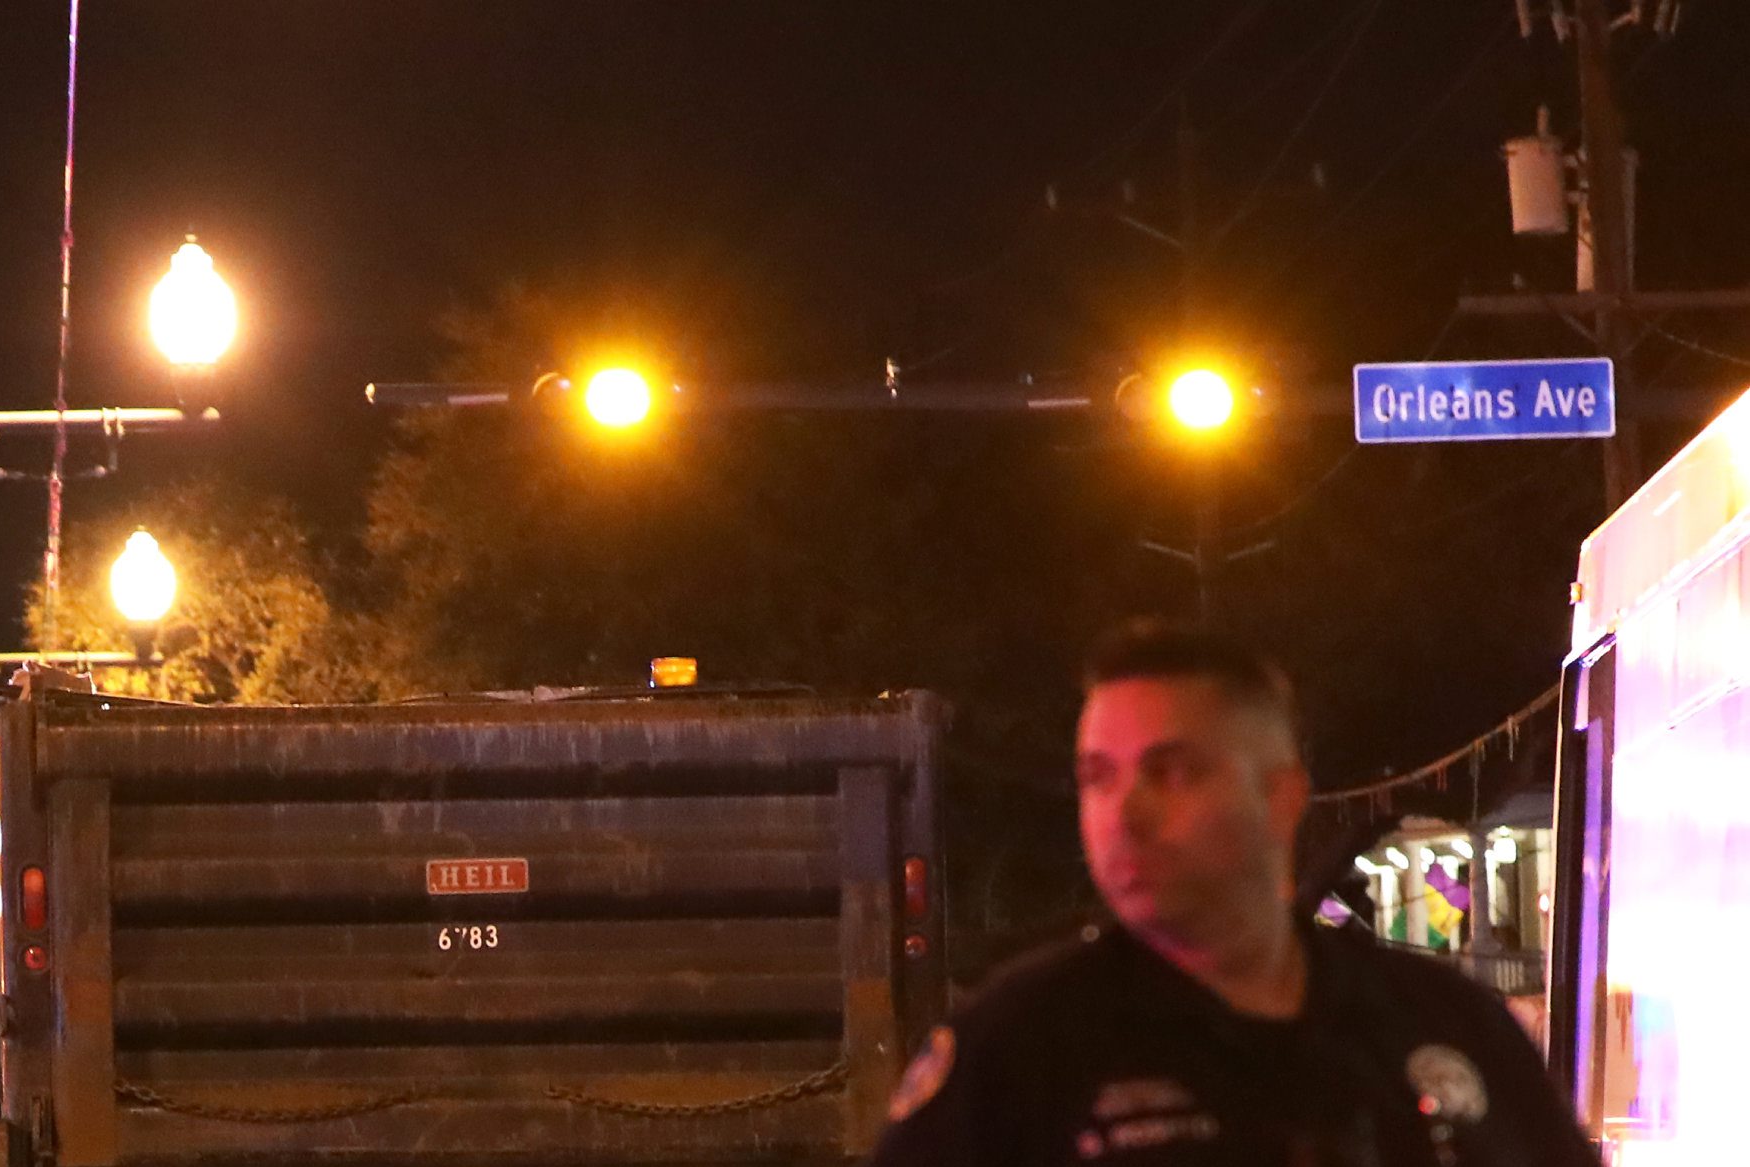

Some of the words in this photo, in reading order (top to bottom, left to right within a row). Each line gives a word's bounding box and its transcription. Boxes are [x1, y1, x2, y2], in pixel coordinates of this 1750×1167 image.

[1373, 383, 1515, 424] Orleans
[1533, 379, 1597, 418] Ave
[439, 865, 515, 887] HEIL
